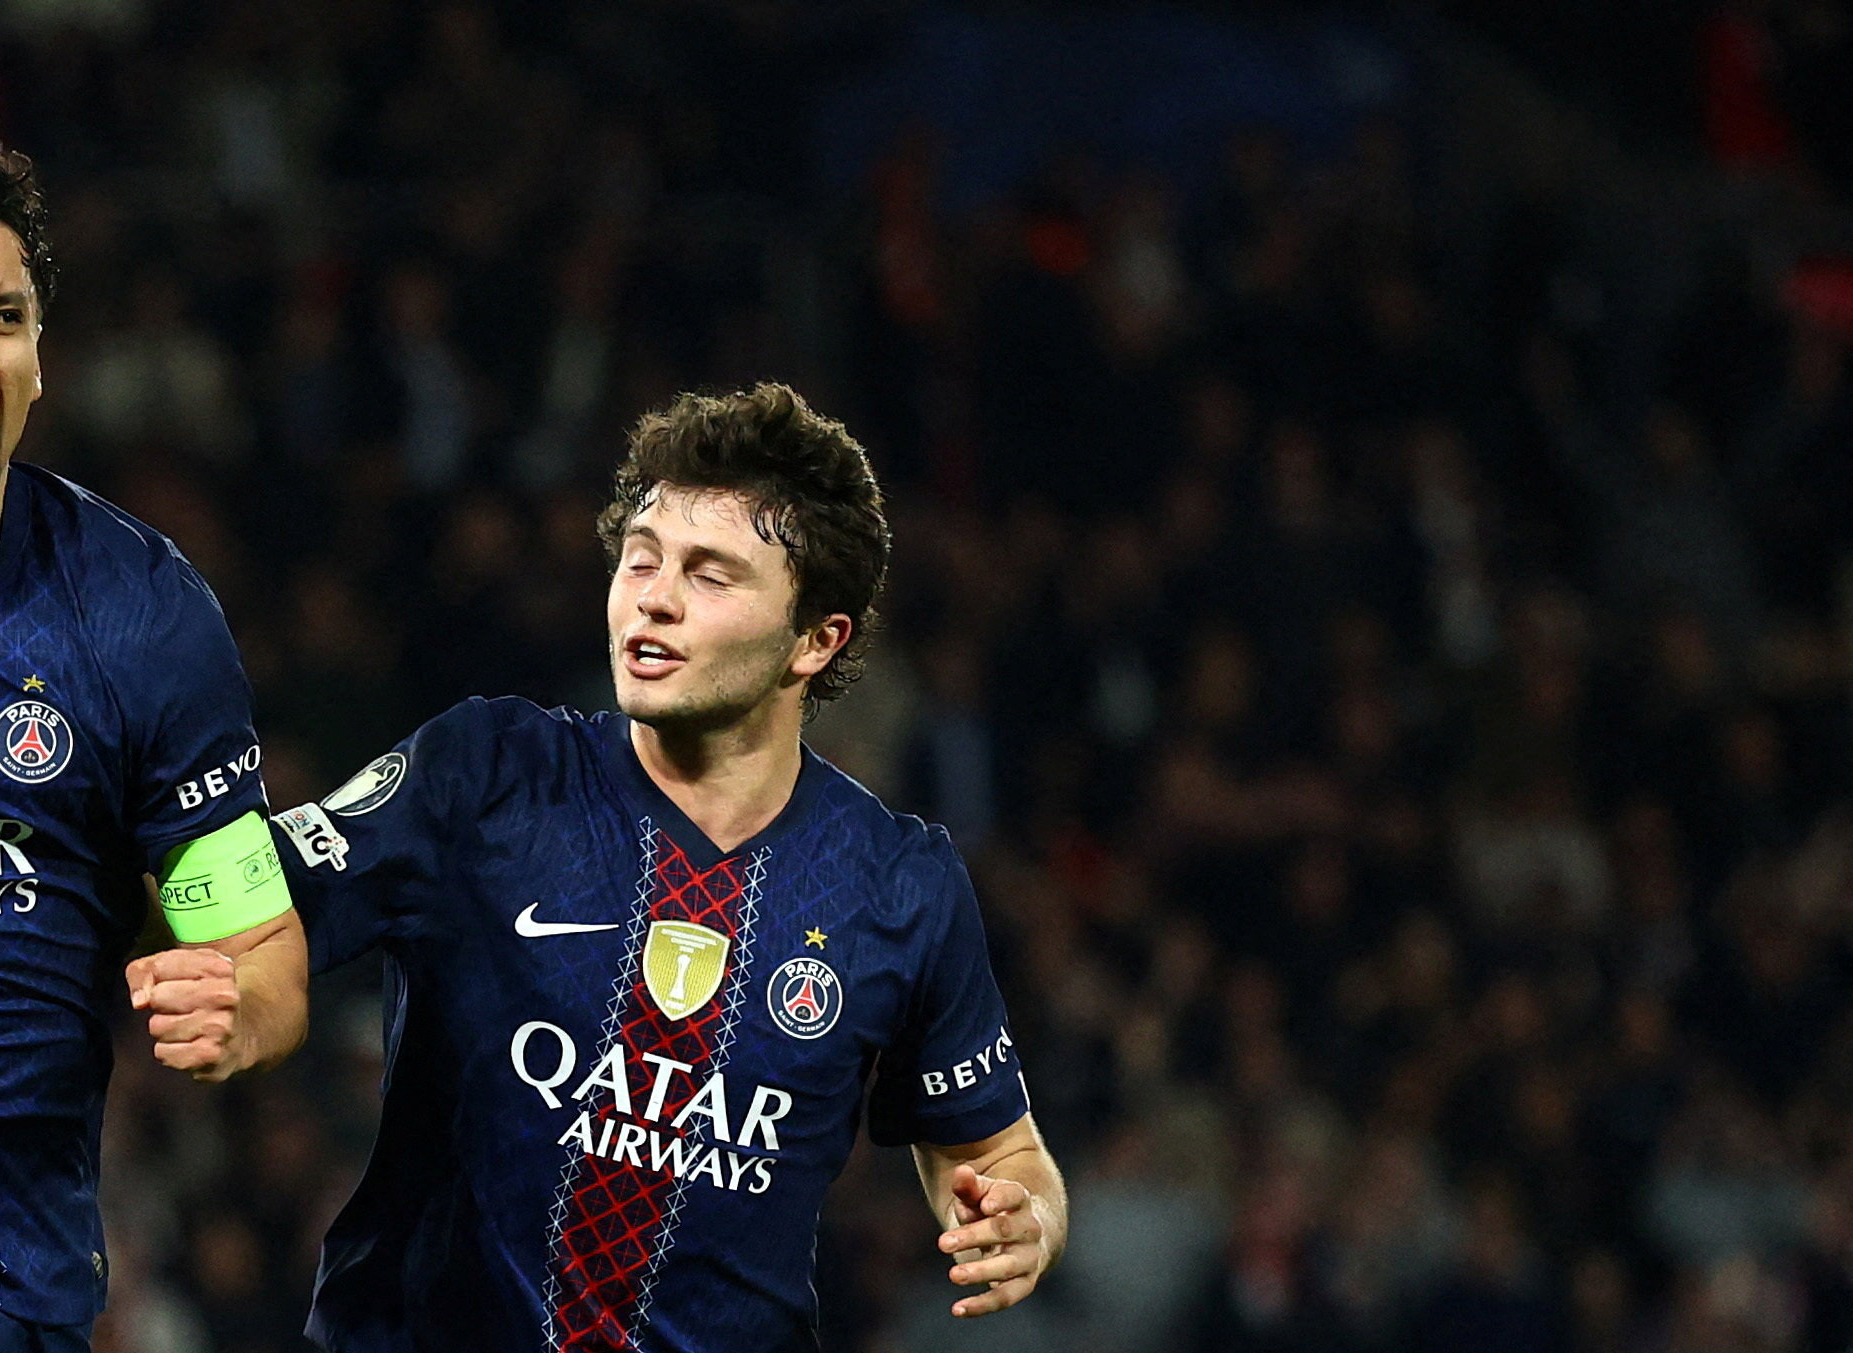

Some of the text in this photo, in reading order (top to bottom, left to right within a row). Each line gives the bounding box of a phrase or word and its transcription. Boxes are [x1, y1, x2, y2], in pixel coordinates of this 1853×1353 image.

[6, 705, 60, 727] PARIS
[784, 962, 834, 987] PARIS
[511, 1021, 793, 1150] QATAR
[557, 1110, 777, 1194] AIRWAYS
